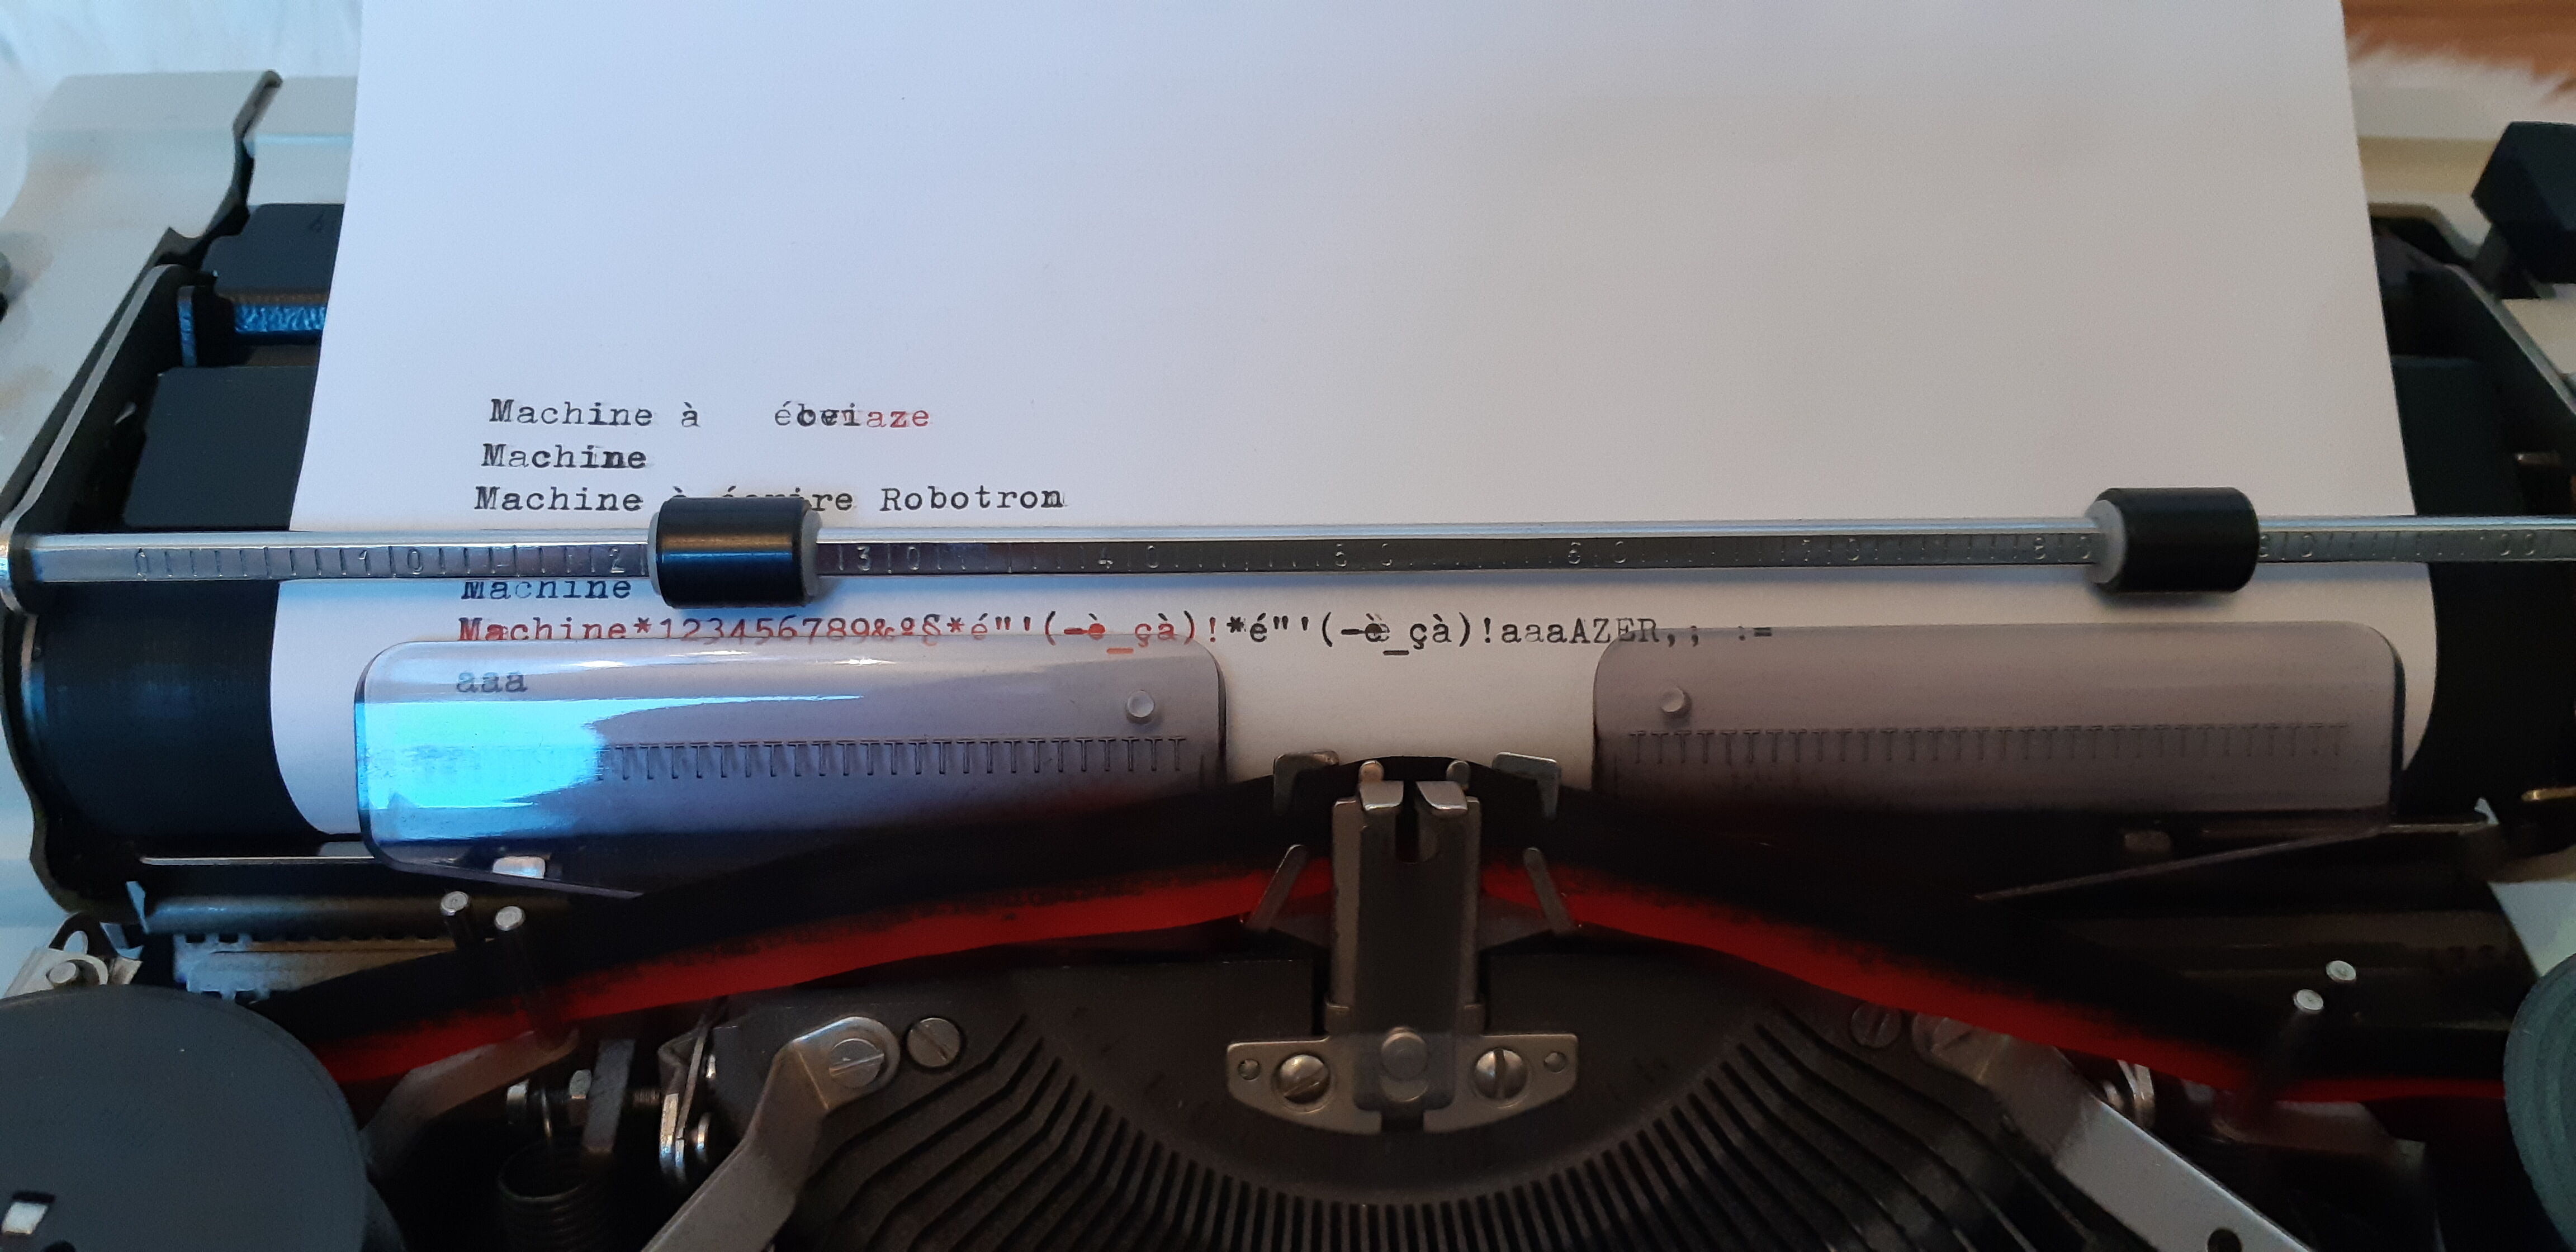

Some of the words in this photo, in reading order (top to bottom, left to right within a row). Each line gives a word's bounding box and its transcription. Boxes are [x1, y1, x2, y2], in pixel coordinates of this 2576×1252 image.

[489, 399, 653, 427] Machine
[681, 401, 701, 428] à
[481, 443, 647, 468] Machine
[473, 486, 645, 512] Machine
[879, 485, 1066, 511] Robotron
[461, 580, 631, 599] Machine
[456, 672, 528, 693] aaa
